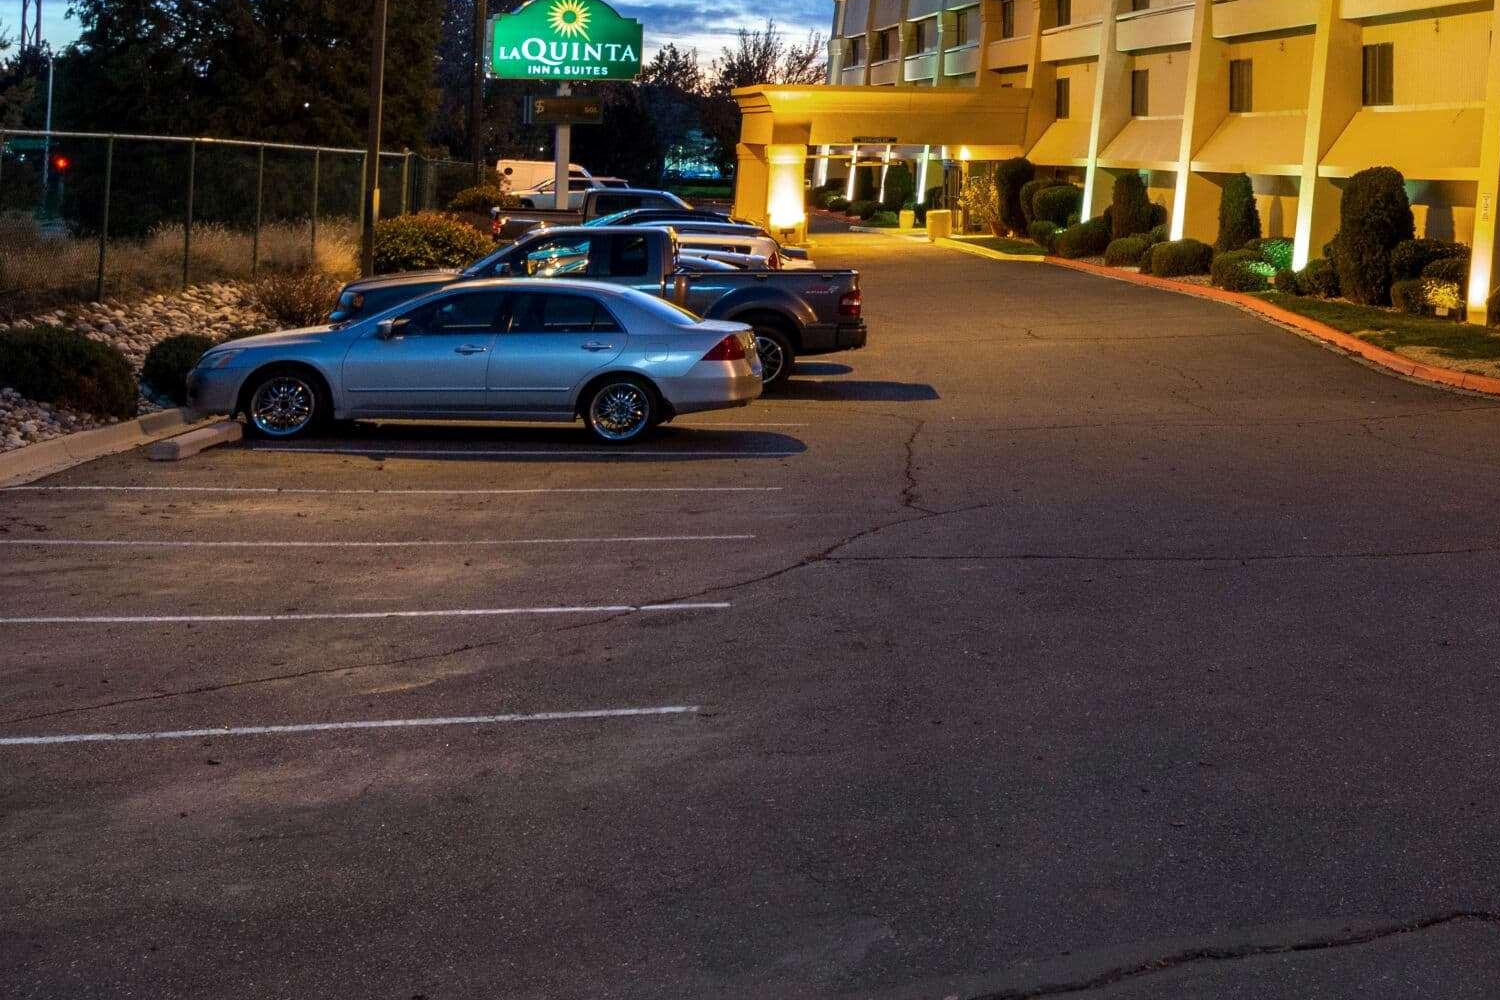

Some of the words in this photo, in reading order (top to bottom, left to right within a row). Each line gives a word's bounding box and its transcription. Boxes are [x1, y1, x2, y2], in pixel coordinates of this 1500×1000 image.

[500, 47, 521, 59] LA
[521, 37, 639, 66] QUINTA
[528, 65, 550, 75] INN
[553, 66, 561, 75] &
[564, 65, 609, 75] SUITES
